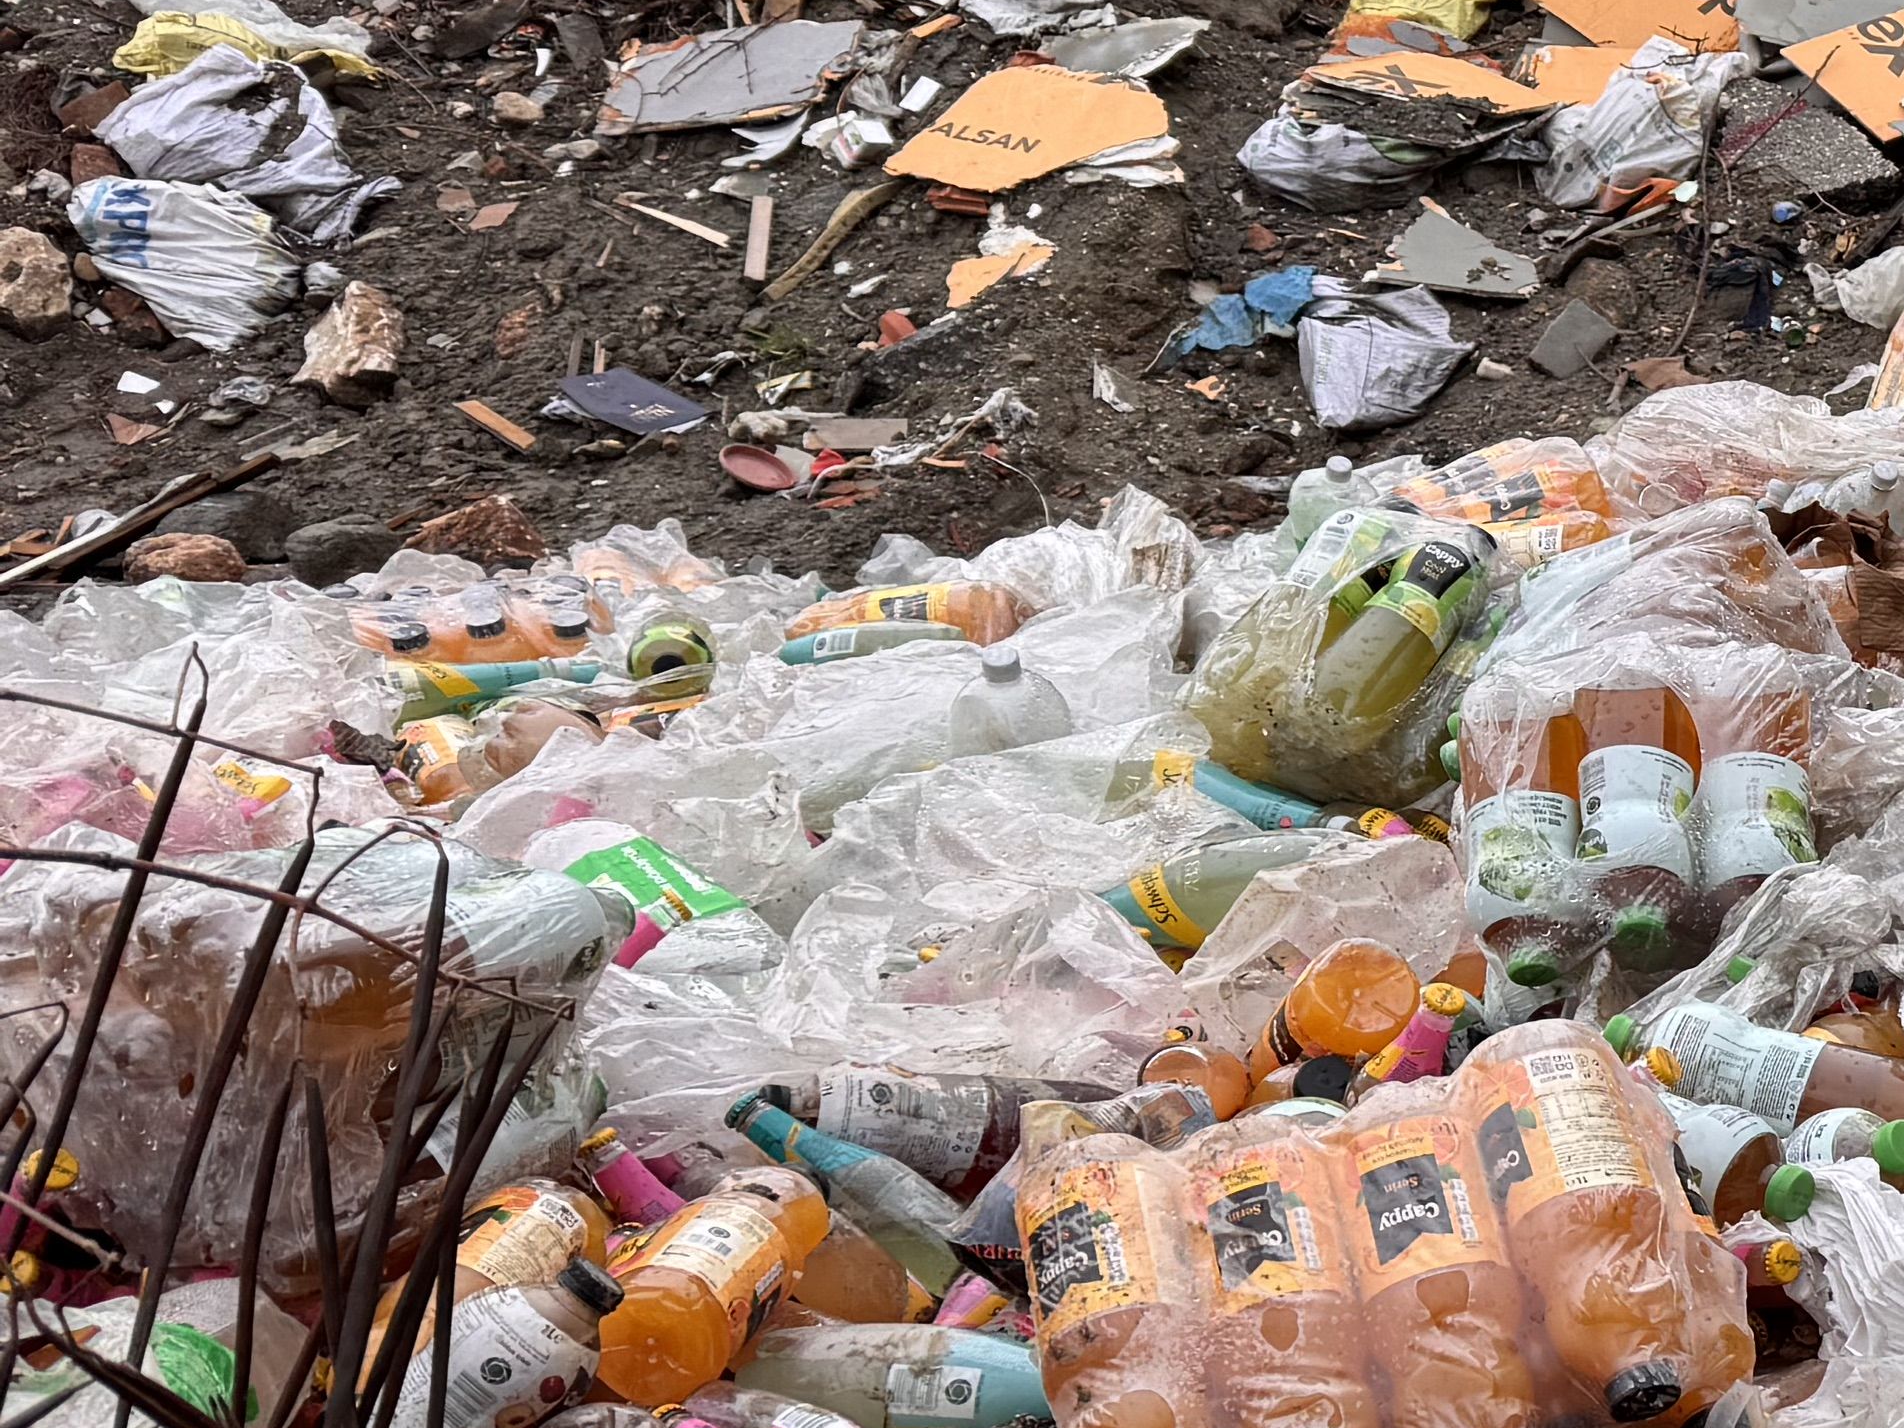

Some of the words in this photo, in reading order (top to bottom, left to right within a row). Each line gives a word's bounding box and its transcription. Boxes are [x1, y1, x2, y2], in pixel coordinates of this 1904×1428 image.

[927, 121, 1042, 154] ALSAN
[1425, 543, 1465, 570] Cappy
[1383, 1175, 1420, 1194] Serin
[1379, 1202, 1442, 1232] Cappy
